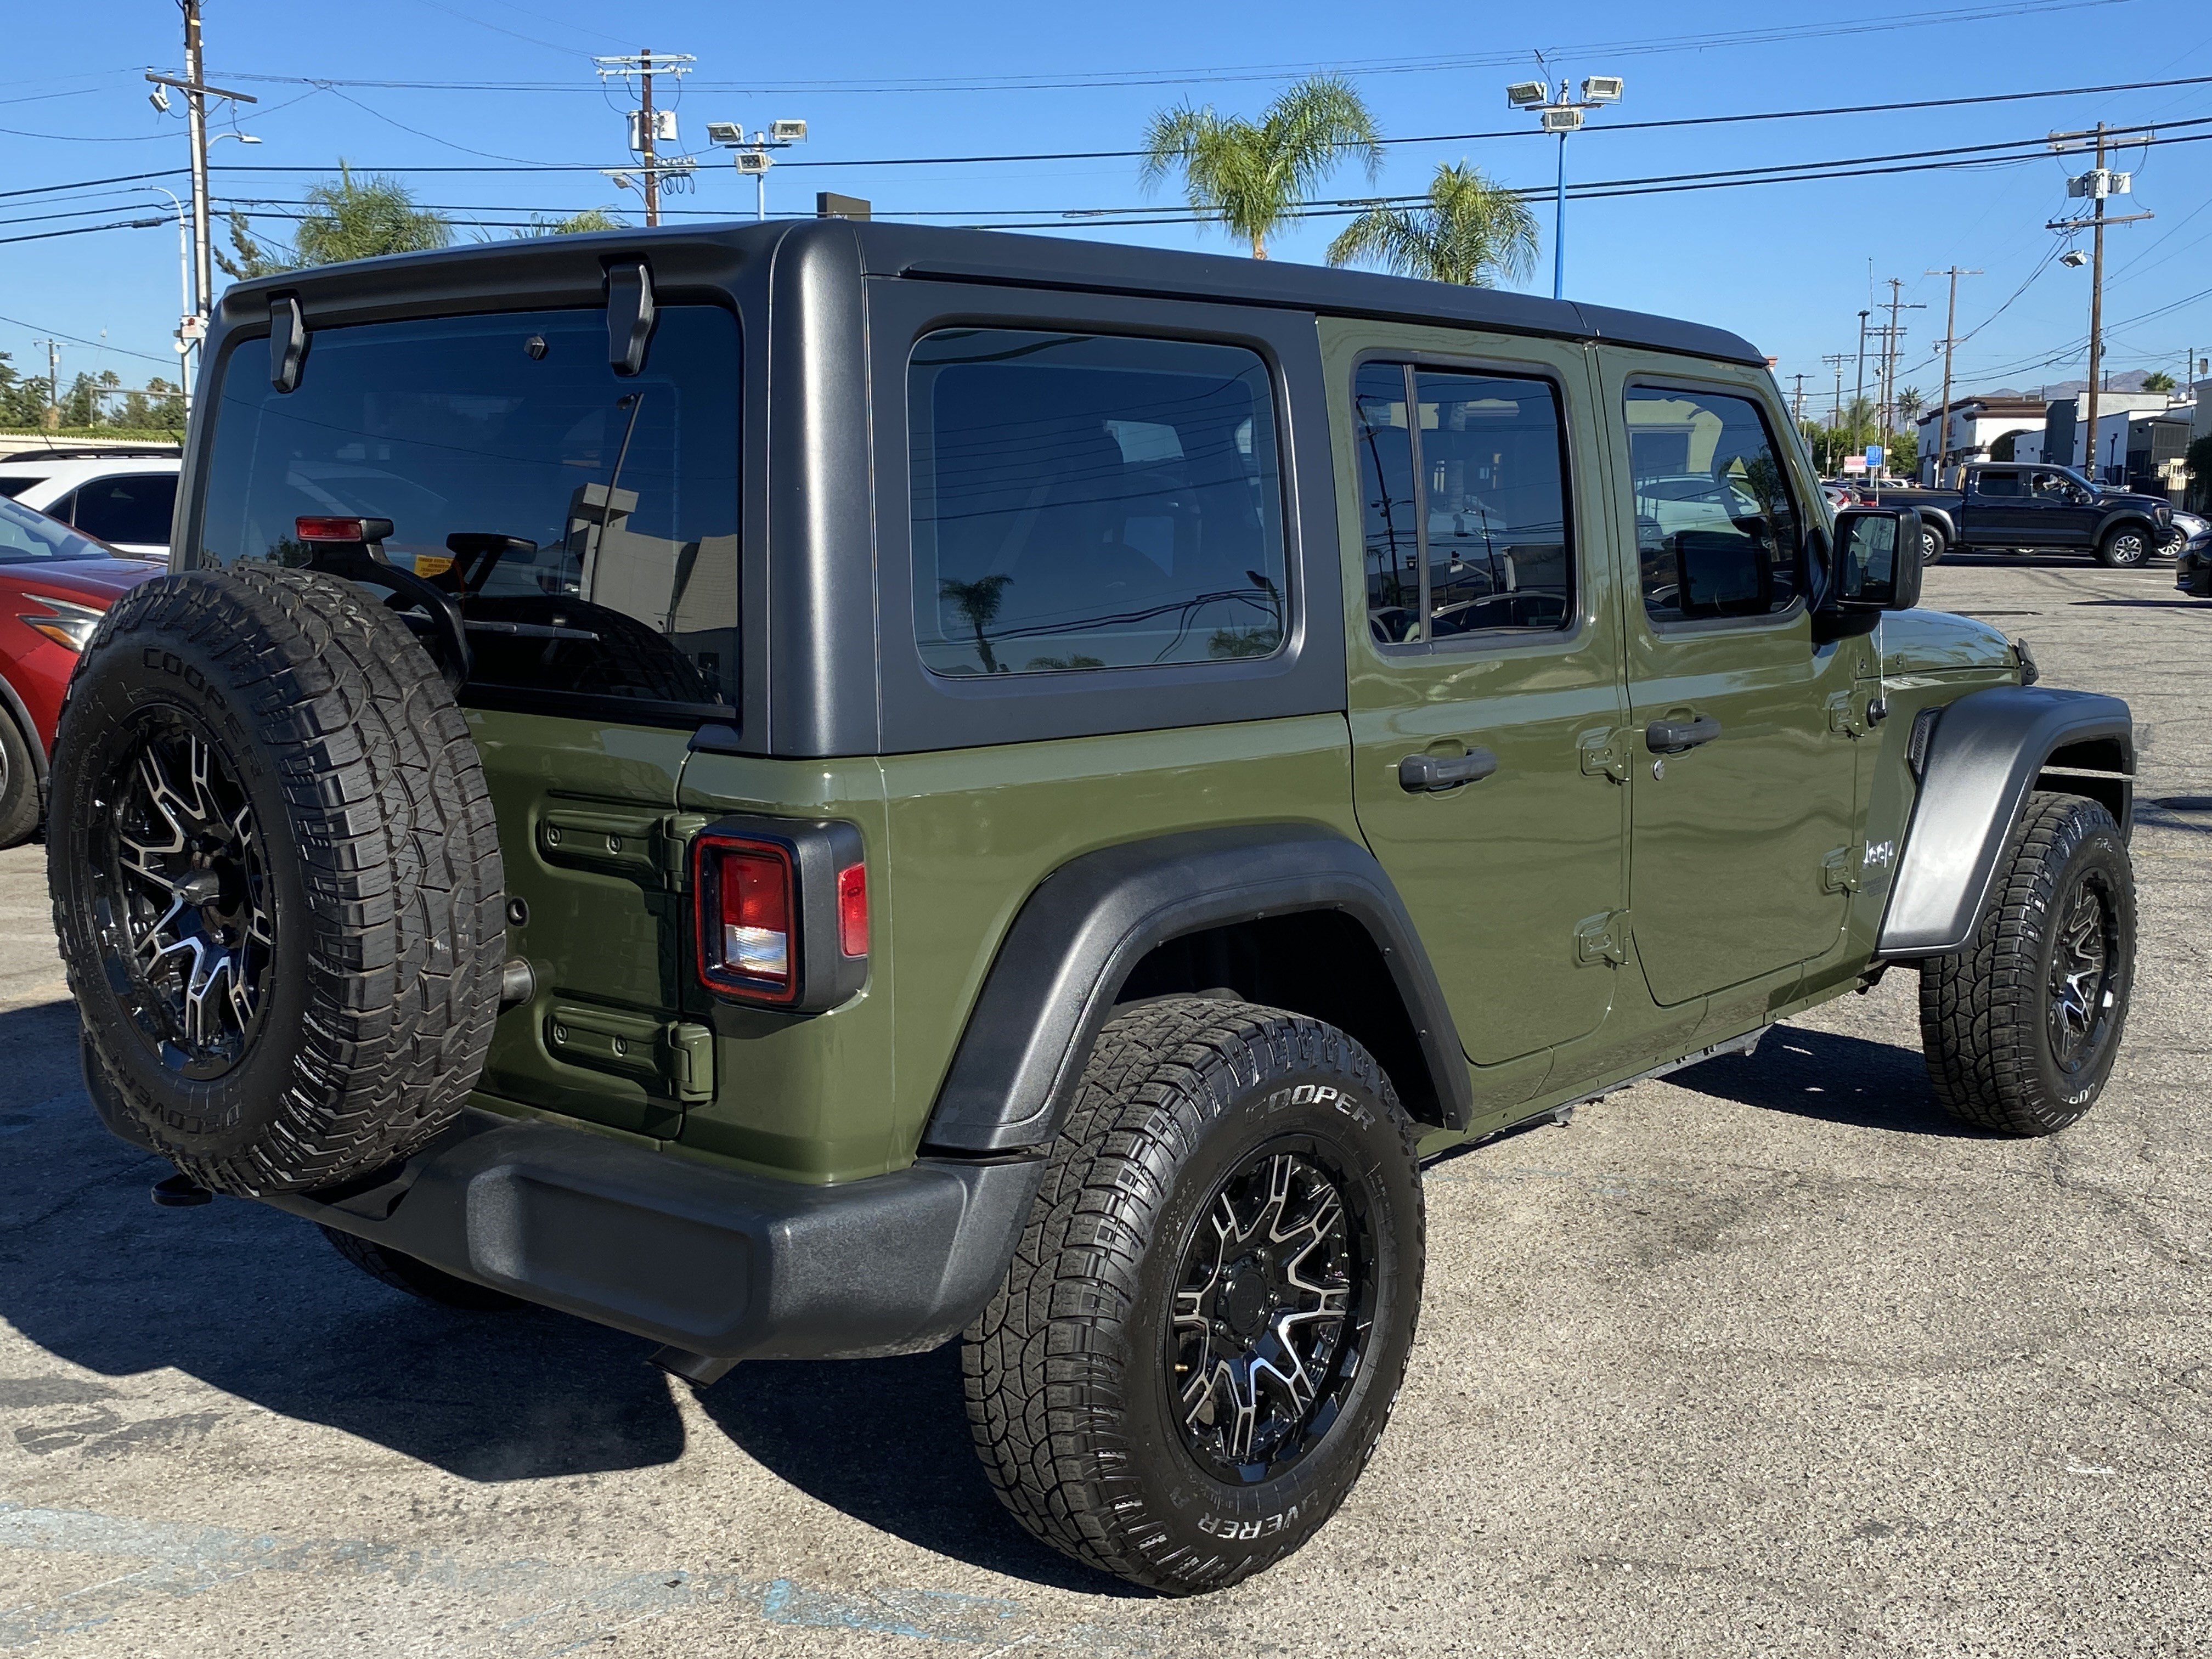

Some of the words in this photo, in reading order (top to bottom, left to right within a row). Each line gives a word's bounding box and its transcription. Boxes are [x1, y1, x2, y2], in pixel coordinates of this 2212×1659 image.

[143, 647, 265, 777] COOPER
[1863, 840, 1893, 868] Jeep
[1244, 1084, 1376, 1131] COOPER
